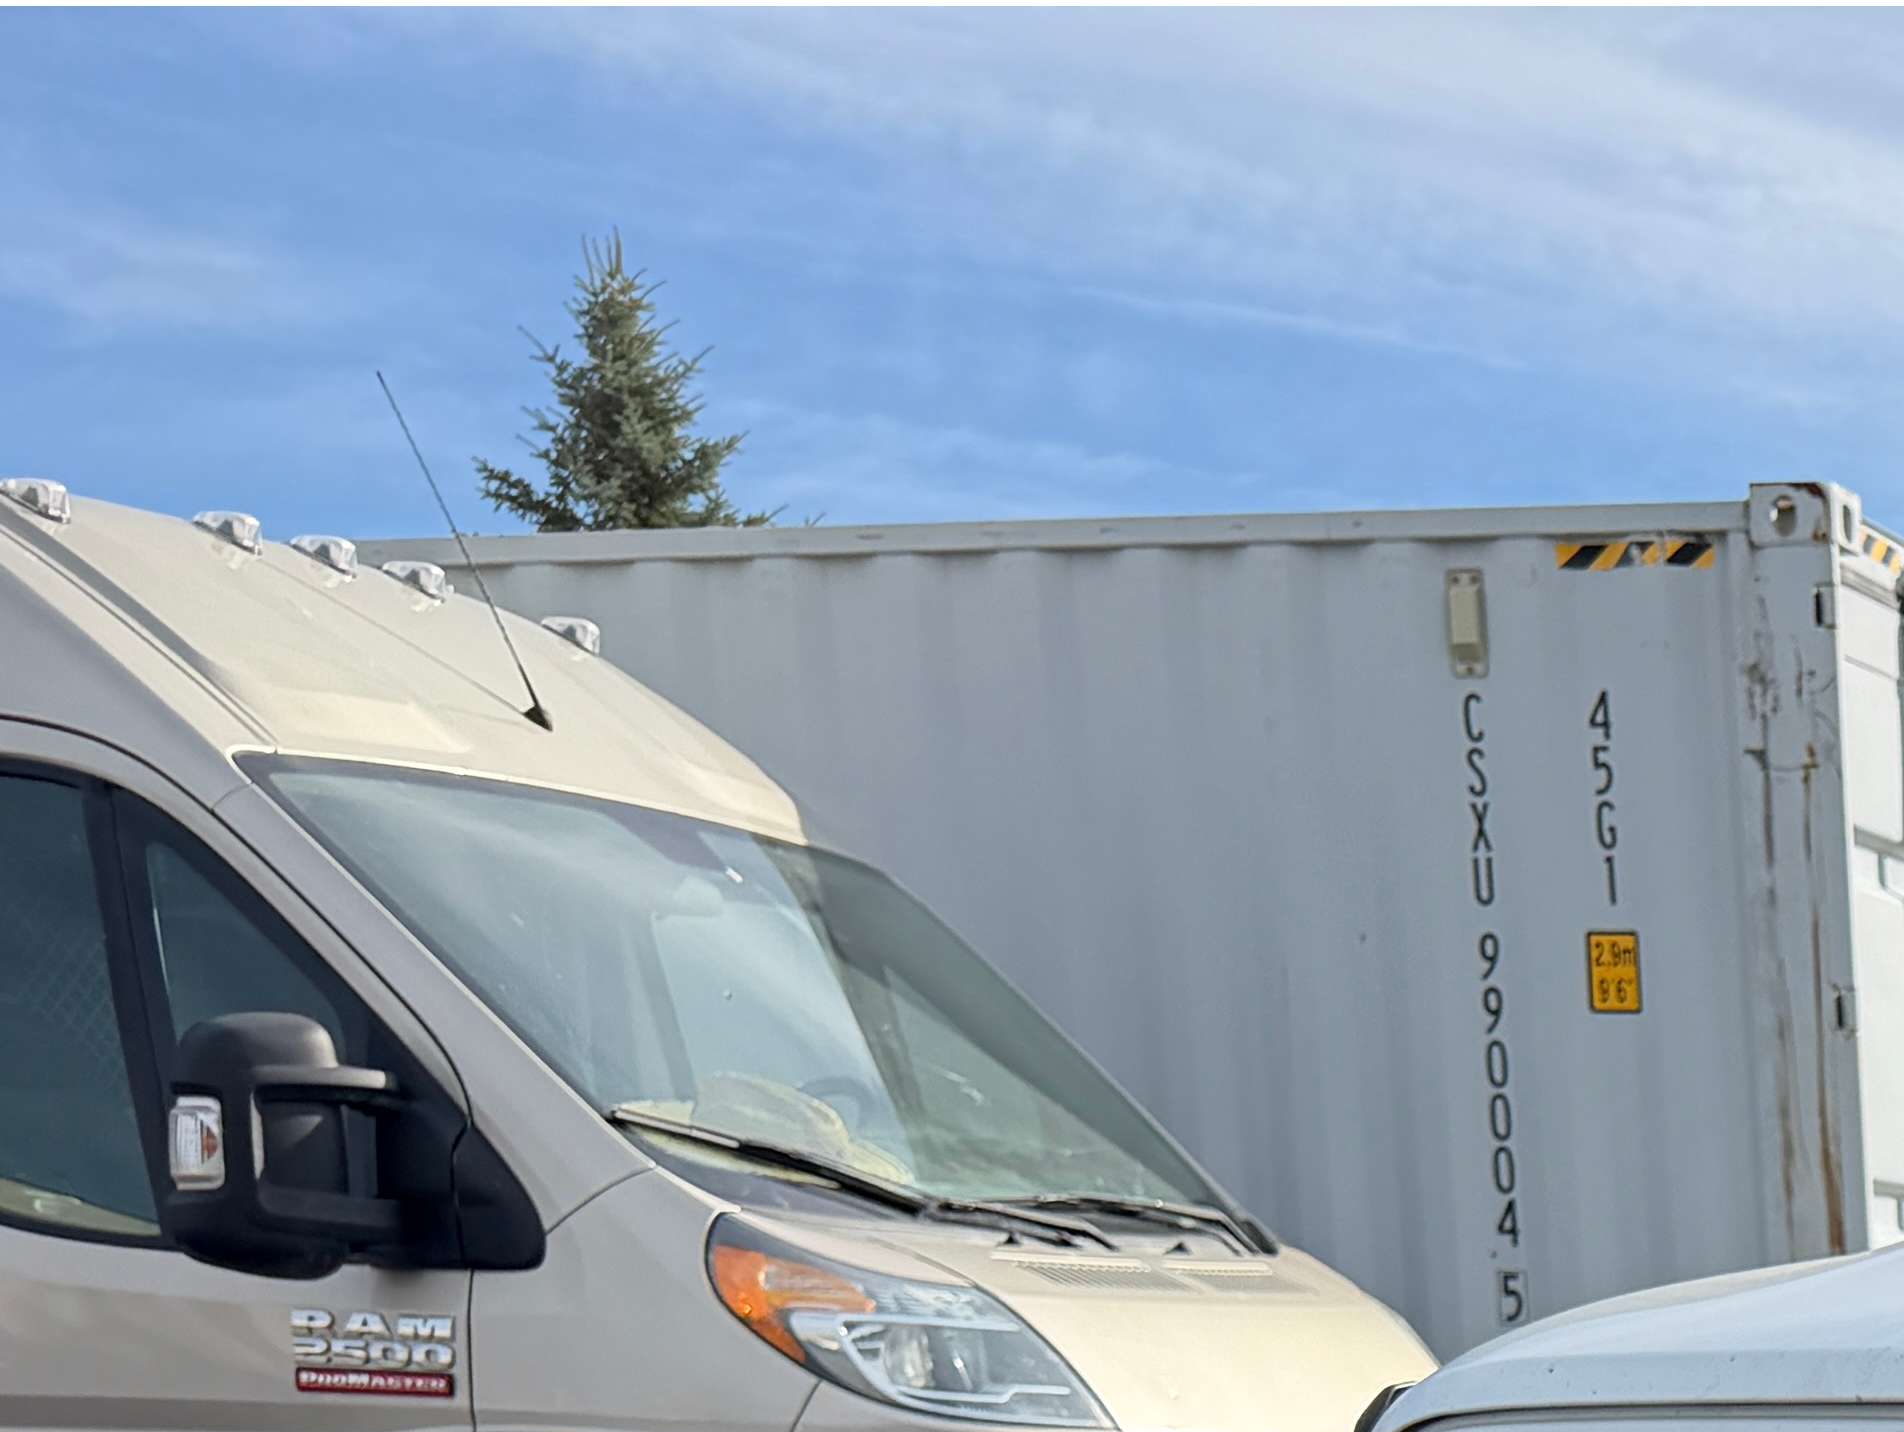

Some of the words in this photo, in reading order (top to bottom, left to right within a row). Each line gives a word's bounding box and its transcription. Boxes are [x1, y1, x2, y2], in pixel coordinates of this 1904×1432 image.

[1464, 693, 1496, 906] CSXU
[1588, 690, 1618, 906] 45G1
[1478, 932, 1520, 1249] 990004
[289, 1308, 455, 1339] RAM
[290, 1336, 455, 1371] 2500
[1501, 1271, 1523, 1322] 5
